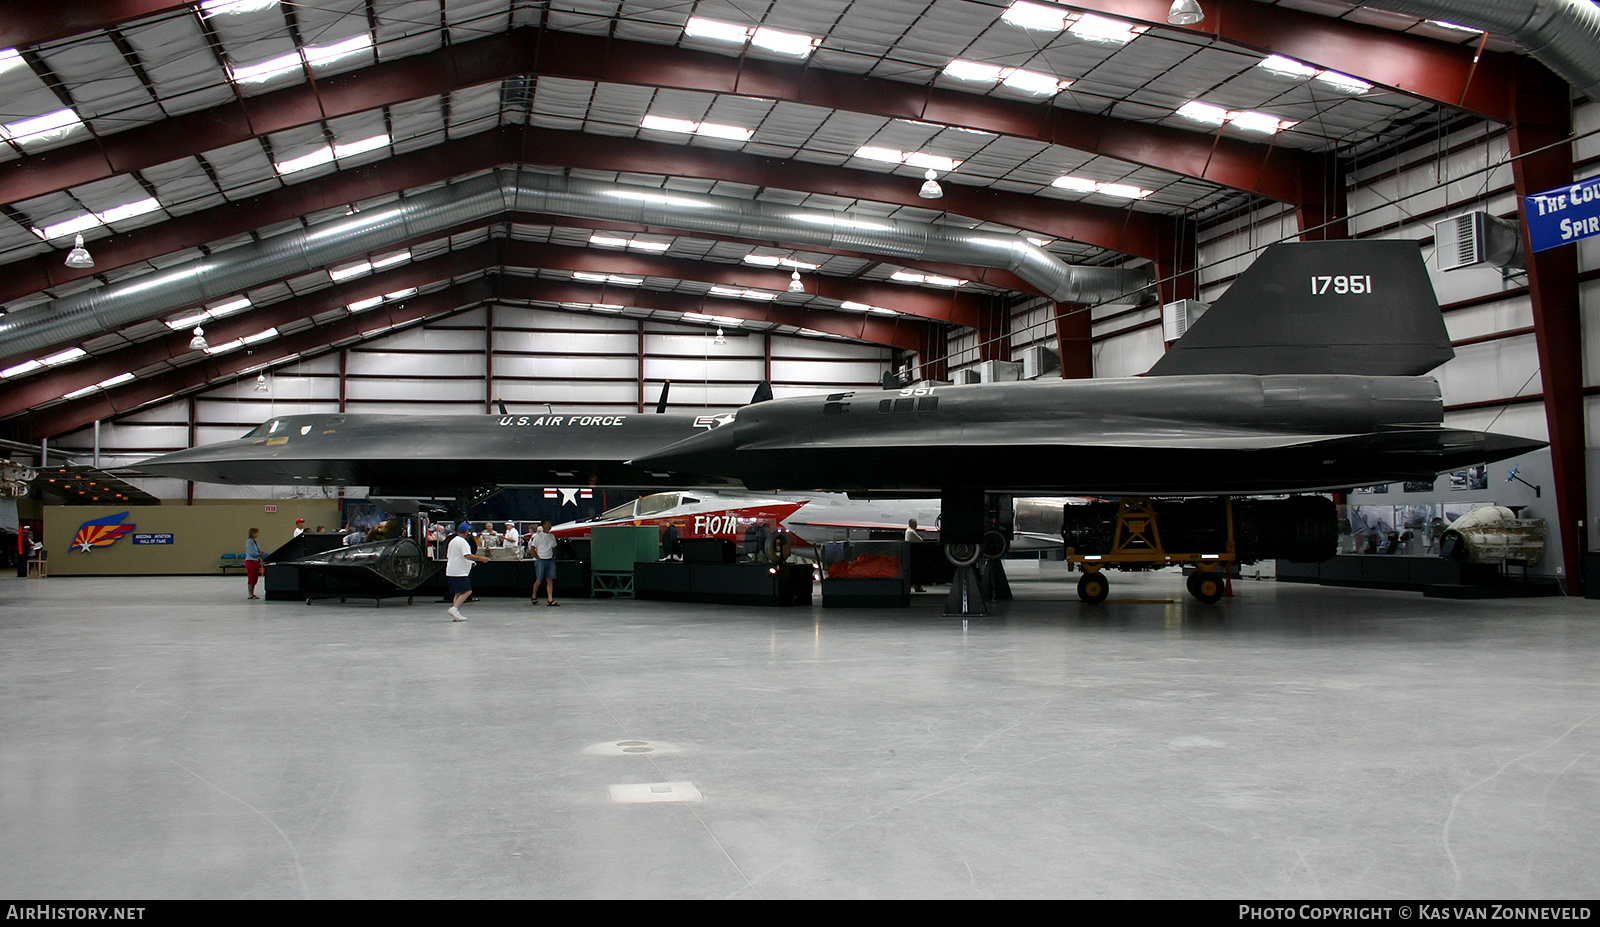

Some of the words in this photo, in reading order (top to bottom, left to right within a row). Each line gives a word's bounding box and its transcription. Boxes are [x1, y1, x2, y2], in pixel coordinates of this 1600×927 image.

[1534, 195, 1567, 216] THE
[1560, 215, 1600, 240] SPIR
[1311, 275, 1372, 295] 17951
[898, 387, 935, 397] 951
[499, 416, 531, 426] U.S.
[533, 416, 564, 426] AIR
[568, 416, 626, 426] FORCE
